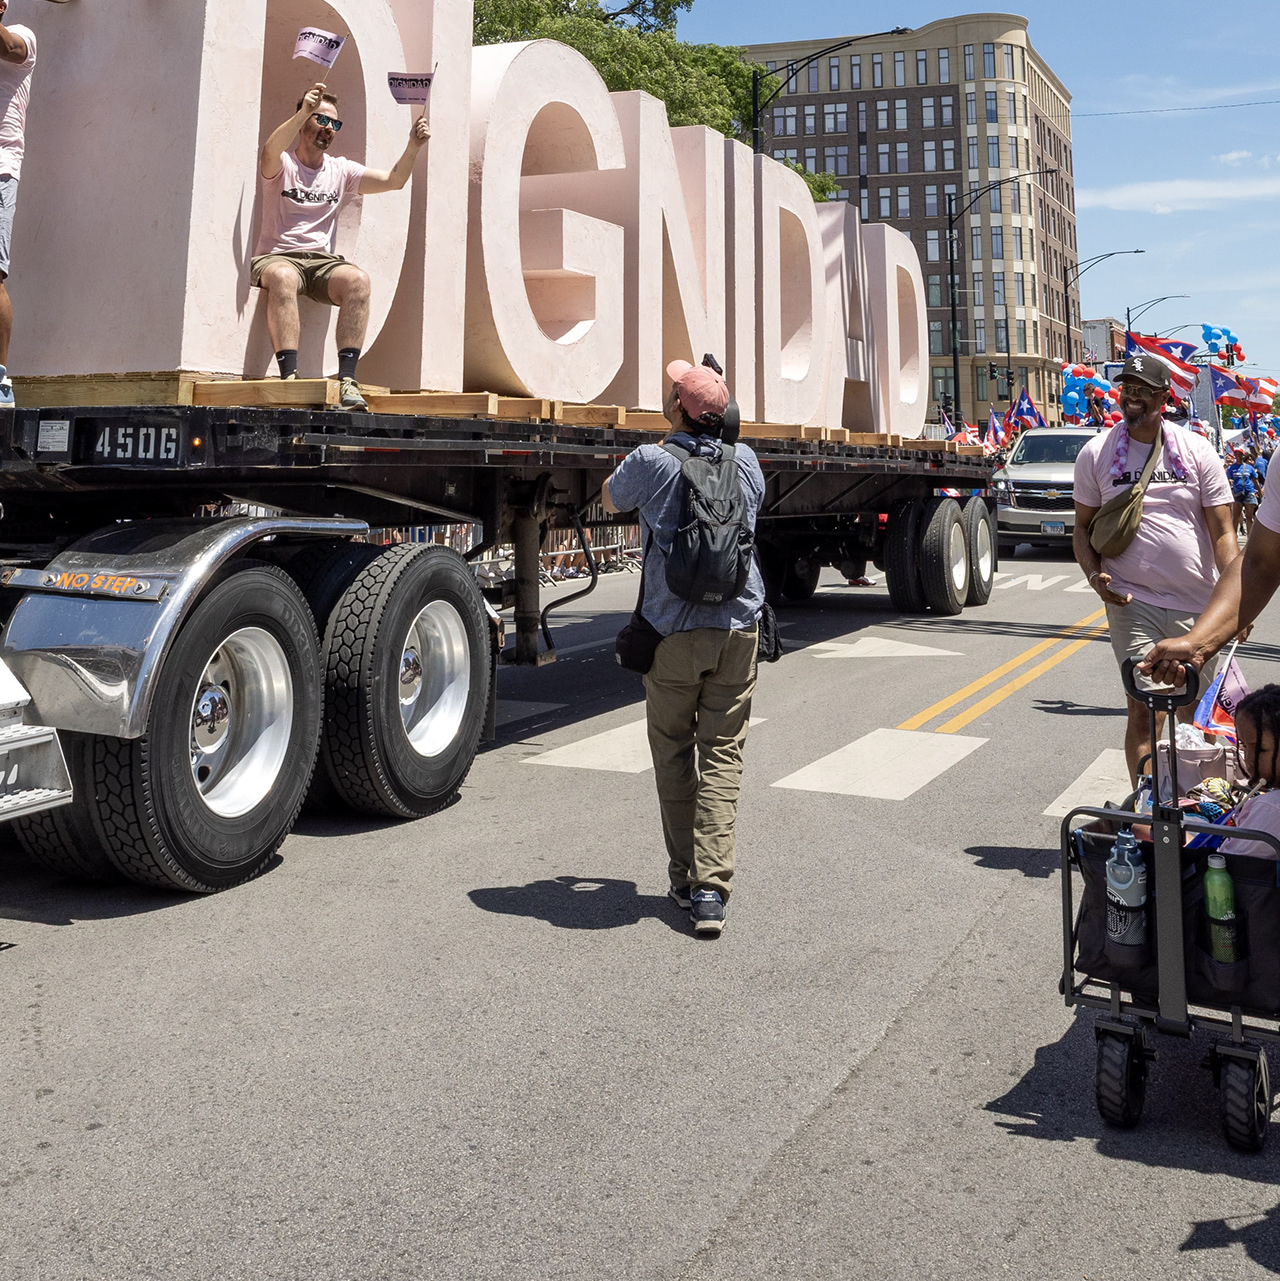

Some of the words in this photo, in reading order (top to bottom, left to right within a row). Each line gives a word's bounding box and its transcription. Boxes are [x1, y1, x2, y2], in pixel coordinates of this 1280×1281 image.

[297, 31, 338, 50] DIGNIDAD
[389, 77, 431, 89] DIGNIDAD
[1134, 469, 1188, 481] DNIDA
[56, 572, 90, 588] NO
[91, 575, 137, 593] STEP
